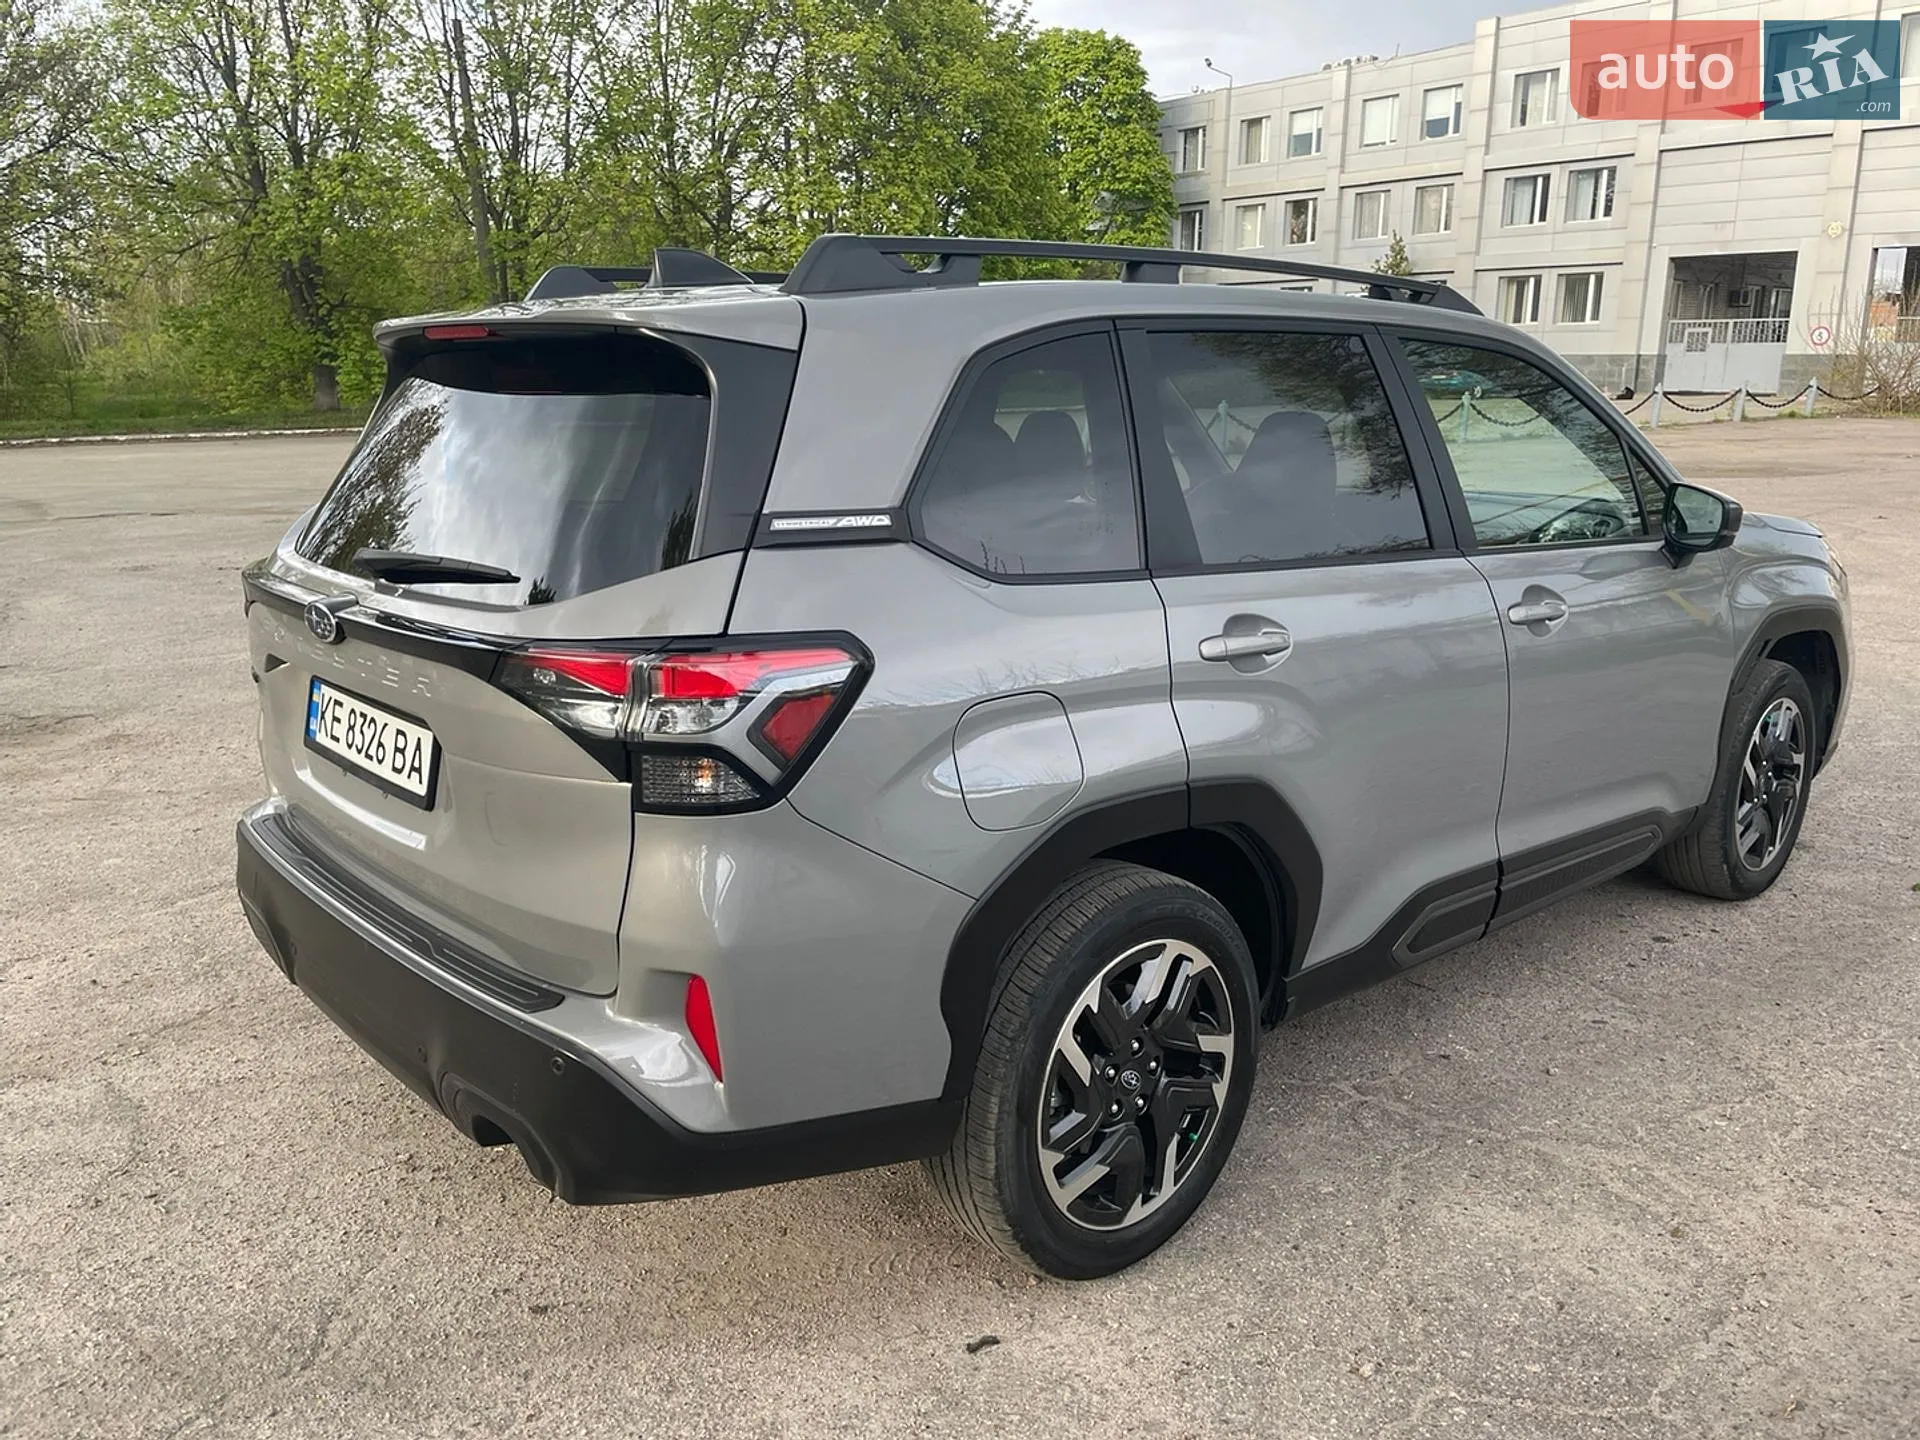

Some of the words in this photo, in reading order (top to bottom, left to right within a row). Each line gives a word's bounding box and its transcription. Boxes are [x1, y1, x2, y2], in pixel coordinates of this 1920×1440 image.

[838, 515, 891, 527] AWD
[318, 692, 344, 743] KE
[345, 708, 388, 765] 8326
[392, 728, 423, 785] BA
